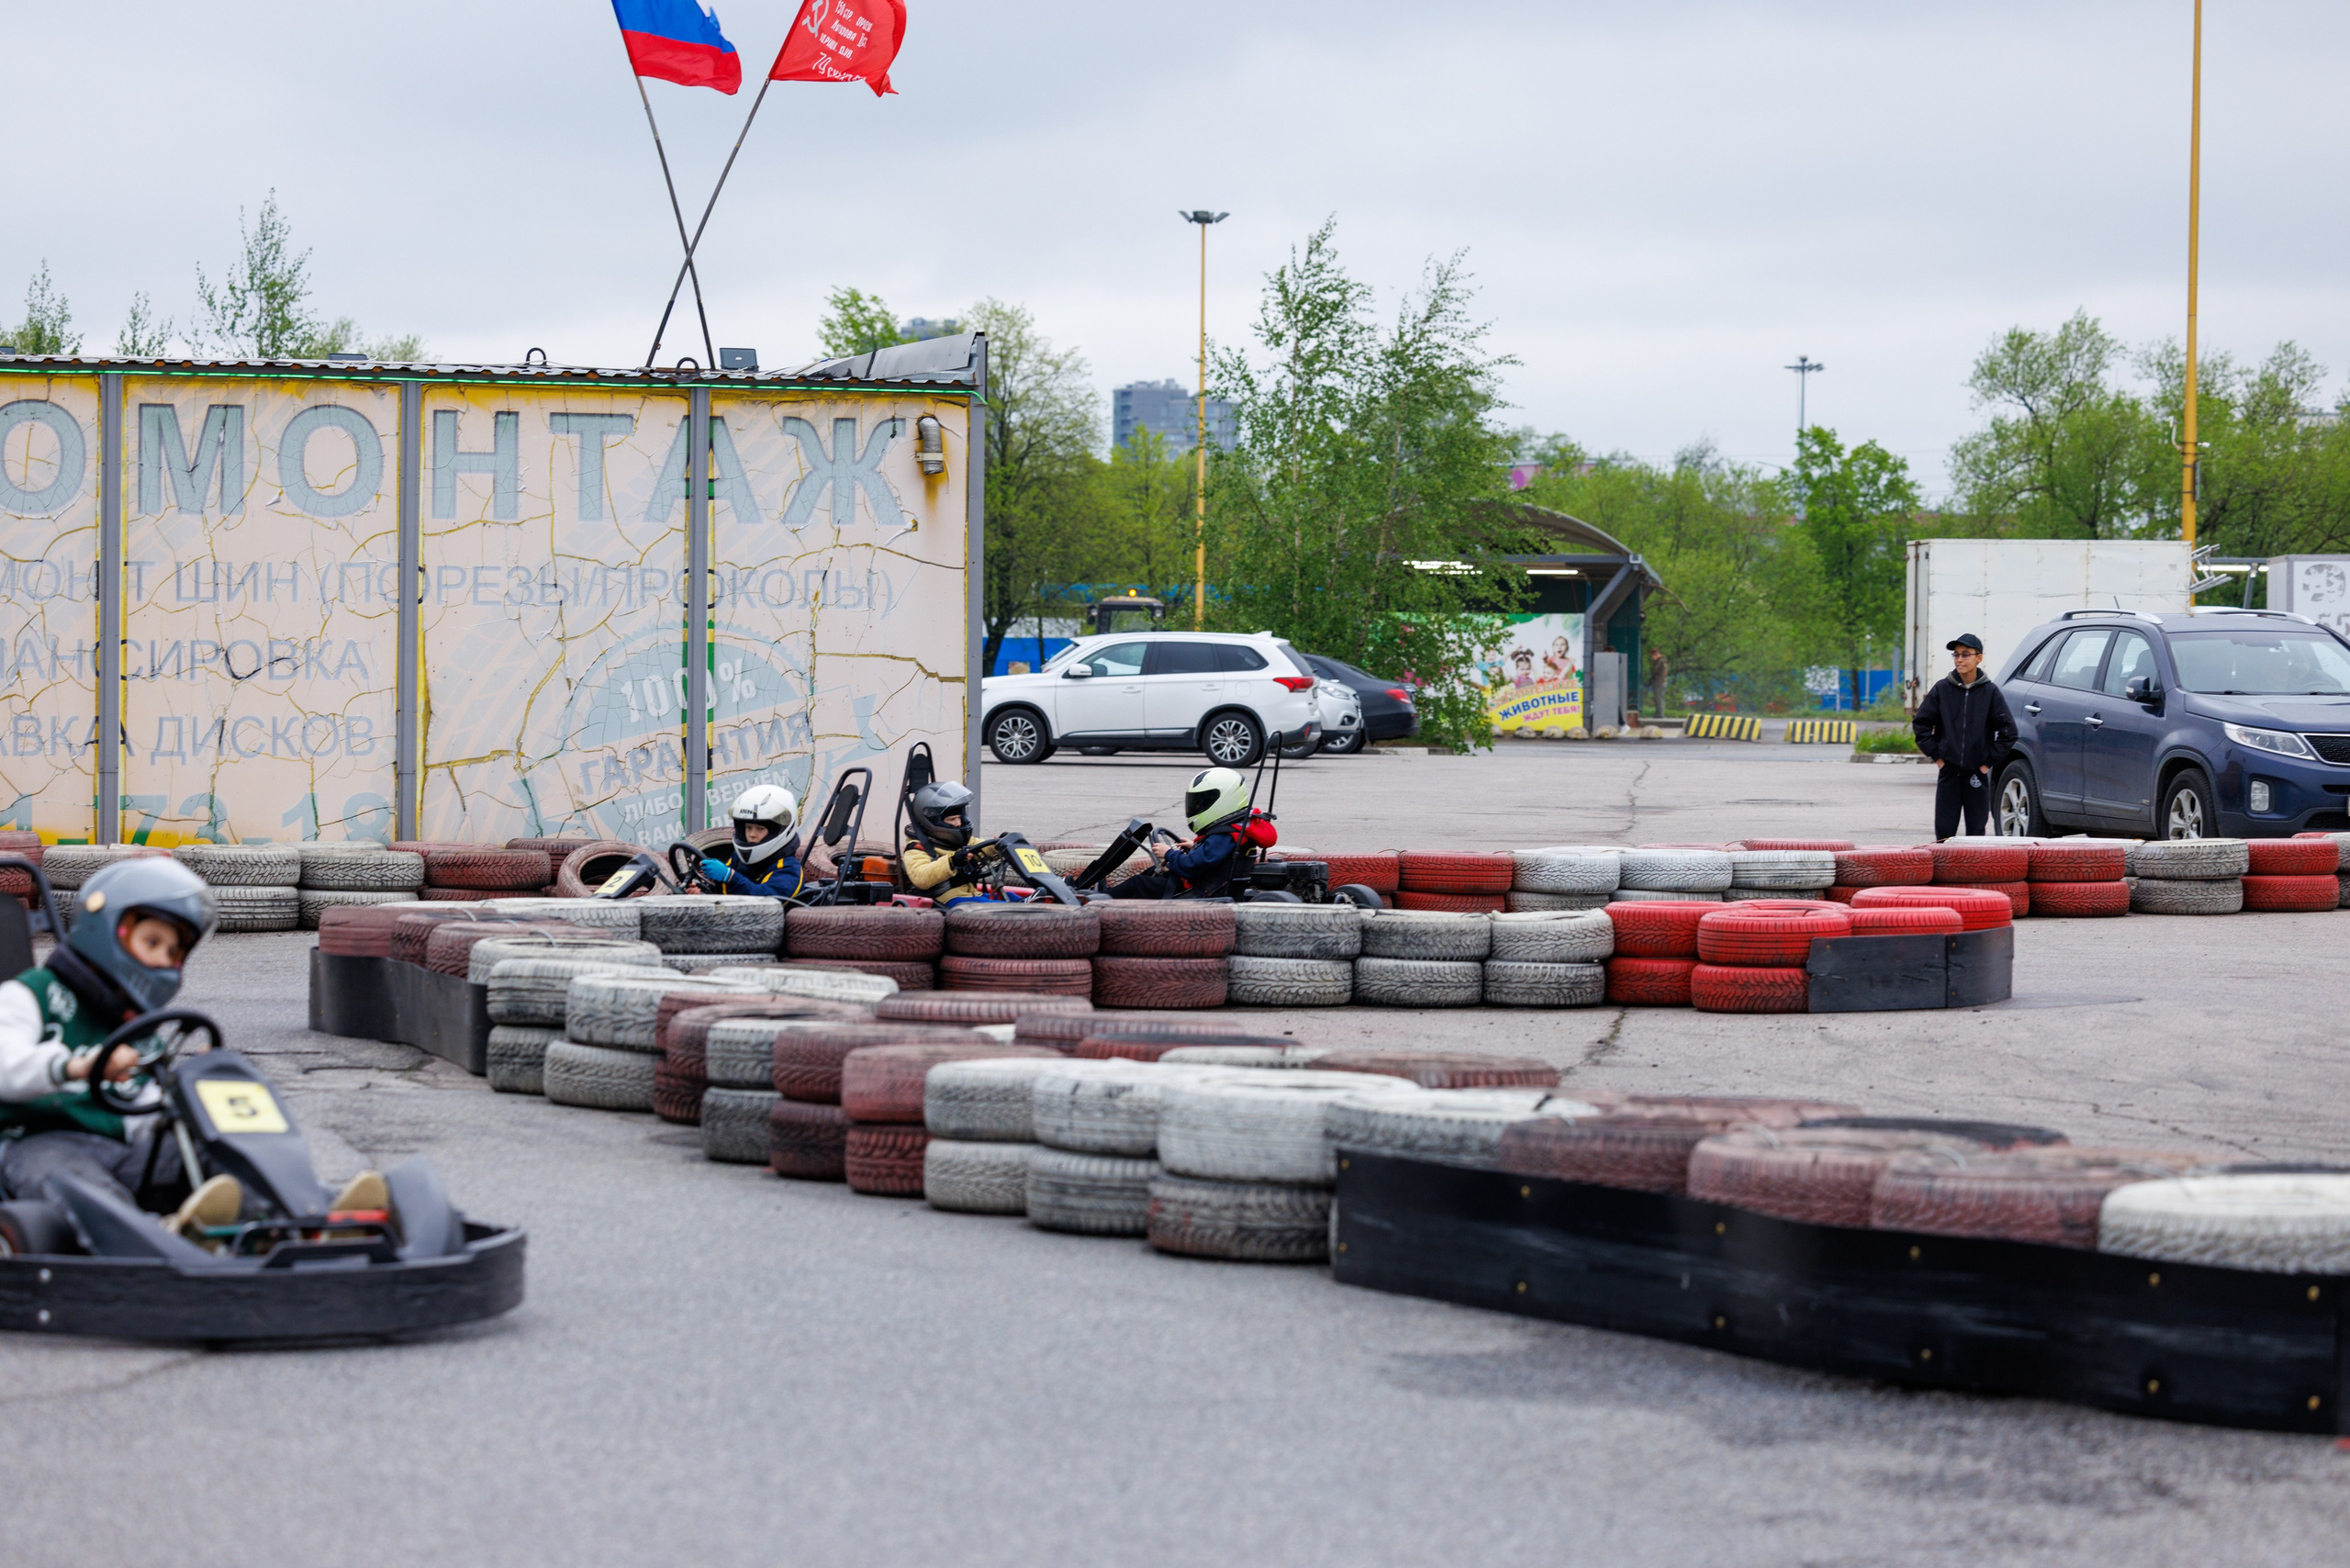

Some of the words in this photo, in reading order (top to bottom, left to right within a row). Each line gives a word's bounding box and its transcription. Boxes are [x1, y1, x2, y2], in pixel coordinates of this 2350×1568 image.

[811, 51, 833, 74] 79
[0, 399, 907, 526] ОМОНТАЖ
[175, 561, 299, 603] ШИН
[0, 638, 369, 682] АНСИРОВКА
[1498, 691, 1579, 722] ЖИВОТНЫЕ
[1523, 709, 1550, 723] ЖДУТ
[1552, 705, 1581, 716] ТЕБЯ!
[0, 714, 136, 757] ВКА
[150, 715, 376, 766] ДИСКОВ
[579, 711, 814, 796] ГАРАНТИЯ
[624, 792, 685, 823] ЛИБО
[636, 820, 687, 846] ВАМ
[1024, 854, 1043, 868] 10
[605, 876, 623, 888] 2
[228, 1094, 259, 1119] 5
